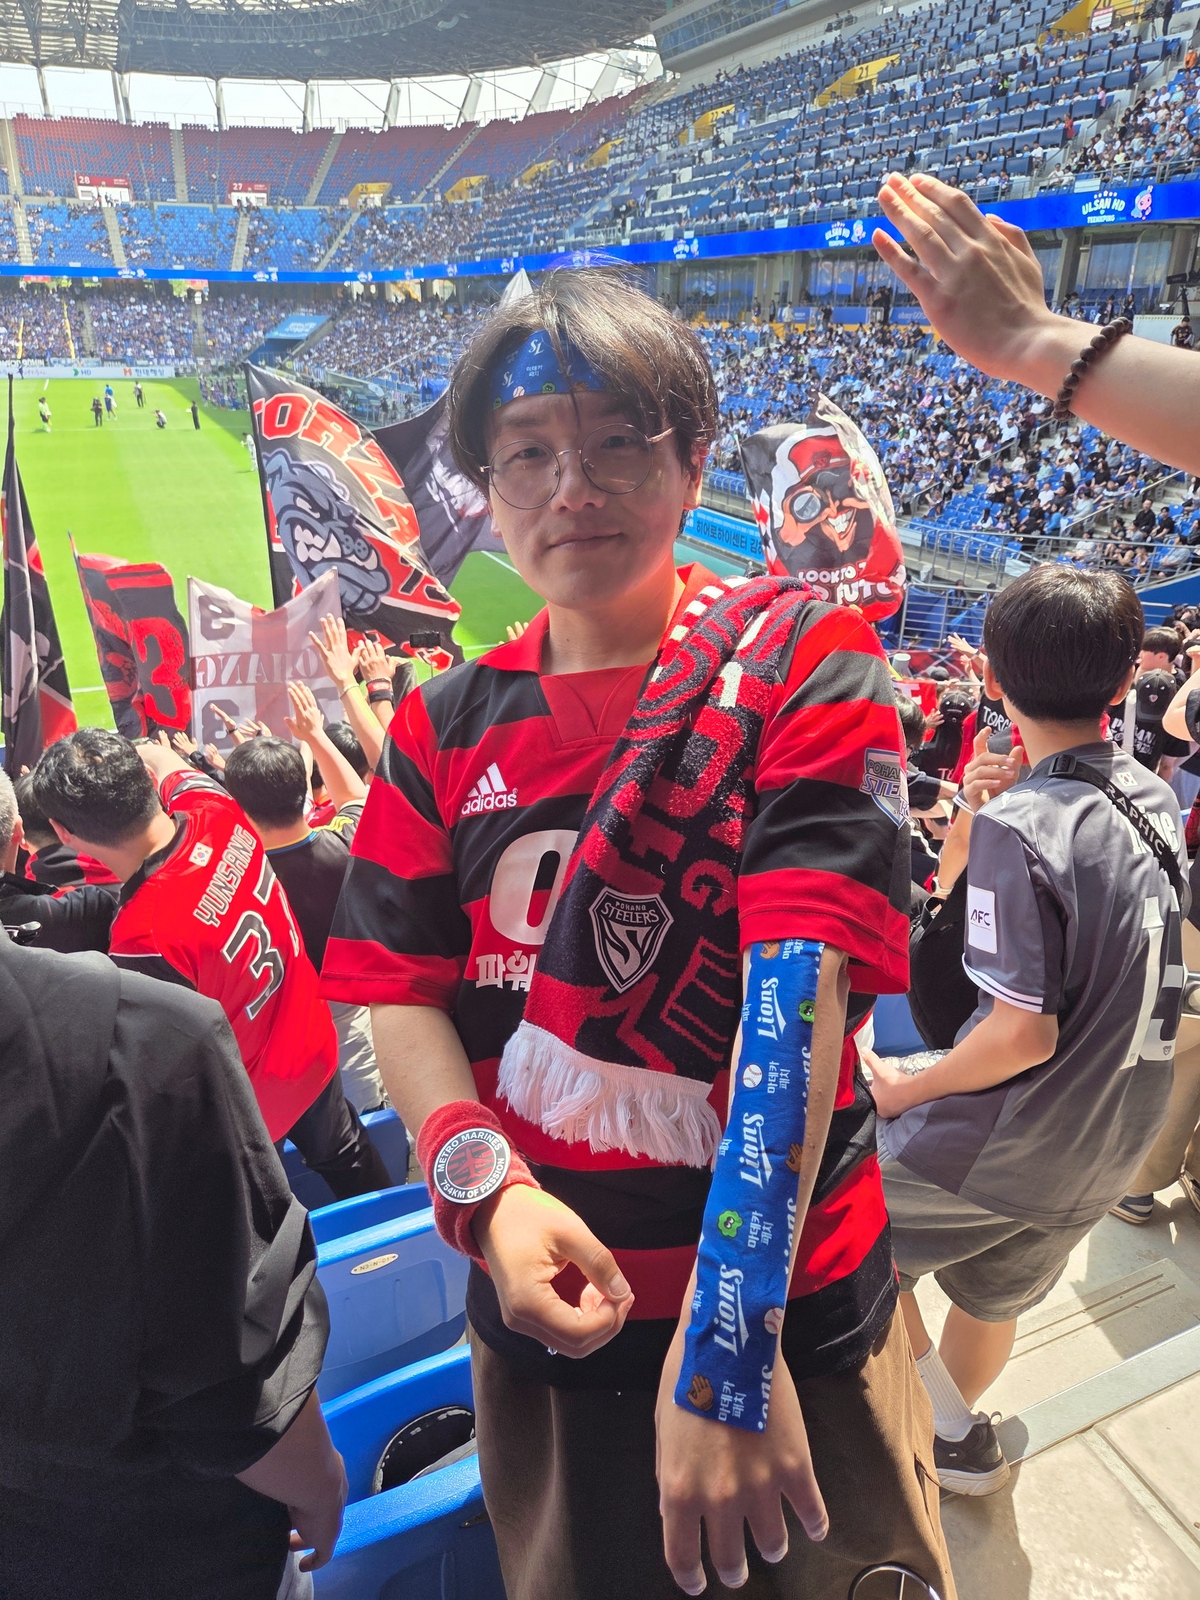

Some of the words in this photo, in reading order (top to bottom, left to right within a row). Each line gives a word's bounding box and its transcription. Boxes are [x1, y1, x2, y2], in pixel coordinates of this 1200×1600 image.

[858, 65, 869, 79] 21
[711, 111, 718, 122] 22
[78, 176, 90, 184] 28
[232, 182, 243, 190] 27
[360, 184, 369, 192] 26
[1081, 198, 1112, 215] ULSAN
[1111, 198, 1126, 212] HD
[798, 570, 840, 583] LOOK
[840, 565, 857, 580] TO
[461, 791, 517, 815] adidas
[193, 823, 256, 927] YUNSANG
[600, 902, 660, 926] STEELERS
[615, 901, 647, 911] POHANG
[970, 908, 991, 927] AFC
[757, 977, 787, 1041] Lions
[766, 1061, 780, 1094] 마데카
[778, 1068, 792, 1091] 패치
[437, 1140, 459, 1173] METRO
[461, 1131, 503, 1151] MARINES
[740, 1112, 774, 1189] Lions
[440, 1179, 466, 1199] 754KM
[467, 1188, 479, 1199] OF
[481, 1157, 505, 1194] PASSION
[747, 1210, 764, 1249] 마데카
[760, 1221, 775, 1246] 패치
[713, 1264, 750, 1357] Lions
[718, 1379, 736, 1422] 마데카
[731, 1391, 748, 1419] 패치
